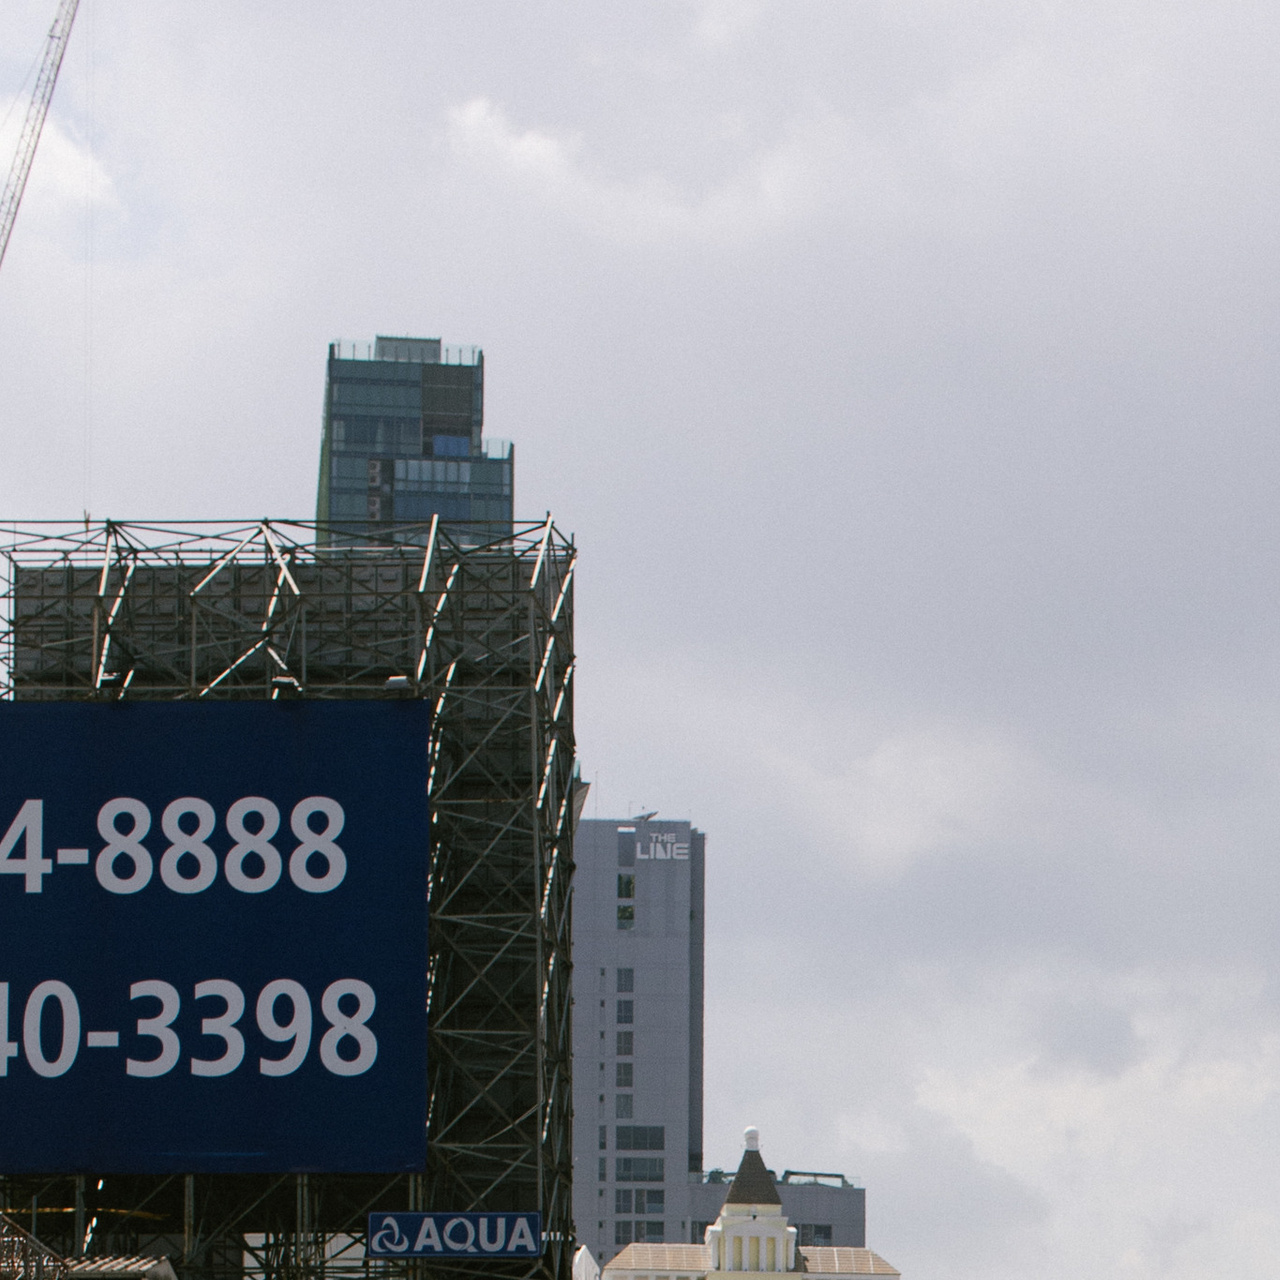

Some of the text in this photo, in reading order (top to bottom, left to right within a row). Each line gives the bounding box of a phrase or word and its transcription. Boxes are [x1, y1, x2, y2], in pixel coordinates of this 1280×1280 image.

[649, 832, 676, 843] THE
[636, 842, 690, 860] LINE
[413, 1216, 537, 1253] AQUA
